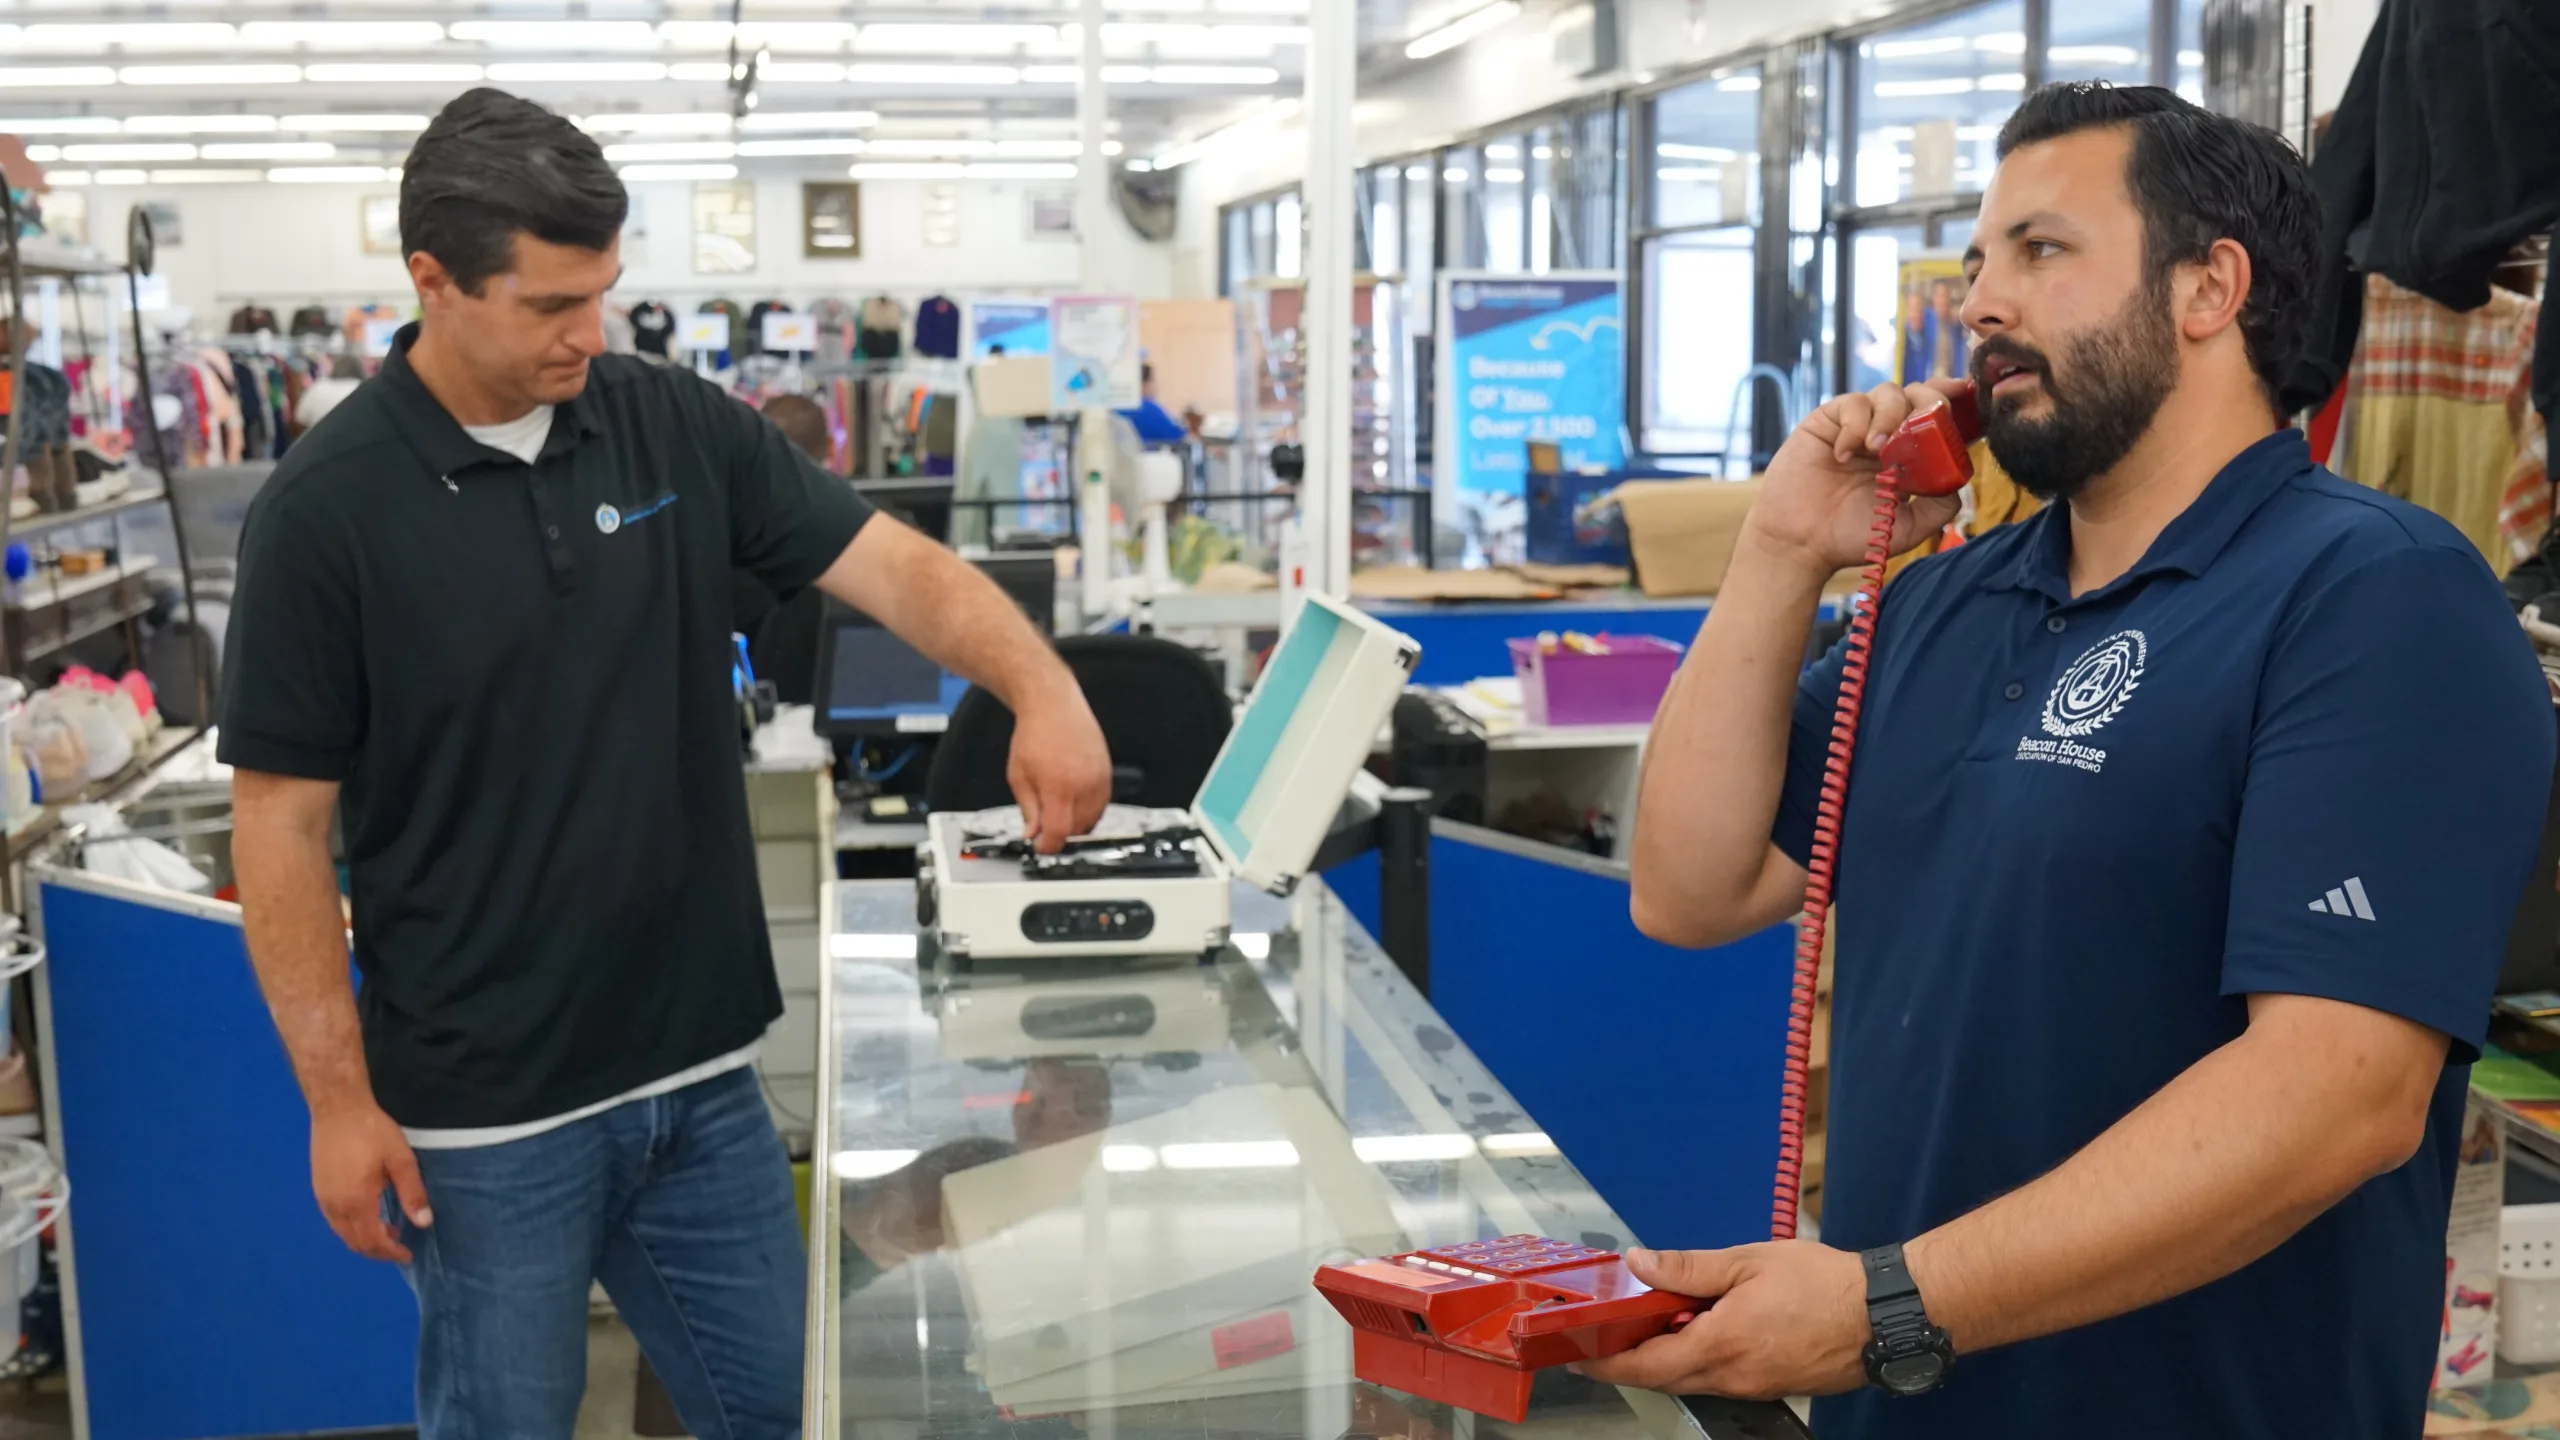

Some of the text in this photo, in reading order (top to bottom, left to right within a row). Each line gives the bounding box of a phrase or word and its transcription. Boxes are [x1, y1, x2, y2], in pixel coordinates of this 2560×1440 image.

[2017, 736, 2106, 763] Beacon House
[2047, 753, 2058, 763] OF
[2057, 755, 2073, 766] SAN
[2072, 757, 2101, 773] PEDRO
